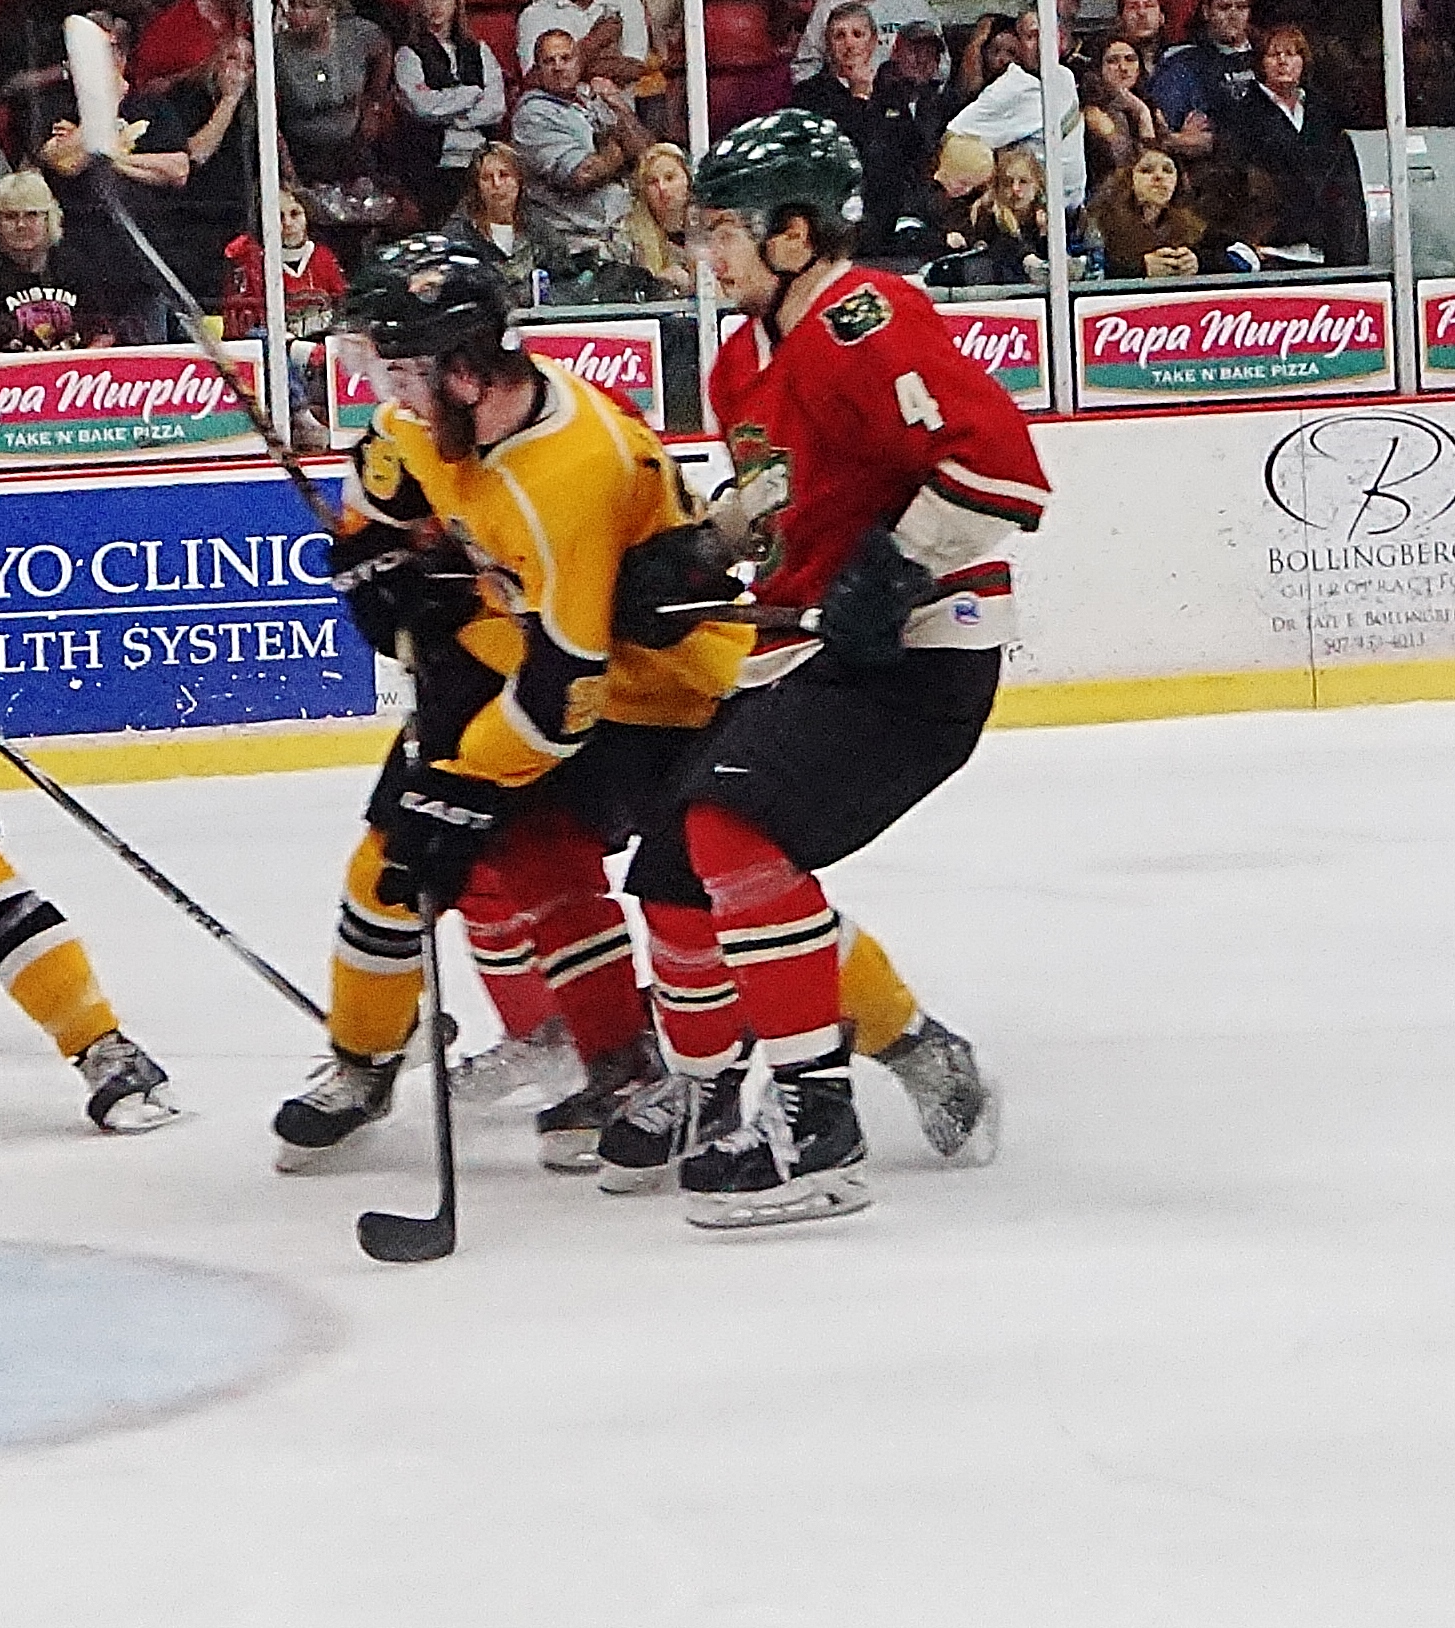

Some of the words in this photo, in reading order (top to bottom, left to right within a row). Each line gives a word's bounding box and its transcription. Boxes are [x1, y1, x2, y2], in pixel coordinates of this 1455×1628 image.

[5, 286, 77, 312] AUSTIN
[1093, 313, 1192, 369] Papa
[1200, 305, 1375, 359] Murphy's
[1151, 369, 1196, 383] TAKE
[1220, 365, 1265, 381] BAKE
[1271, 362, 1319, 378] PIZZA
[894, 370, 945, 432] 4
[4, 432, 51, 447] TAKE
[78, 427, 127, 443] BAKE
[133, 424, 185, 440] PIZZA
[90, 531, 336, 594] CLINIC
[1268, 541, 1455, 575] BOLLINGBER
[122, 618, 339, 669] SYSTEM
